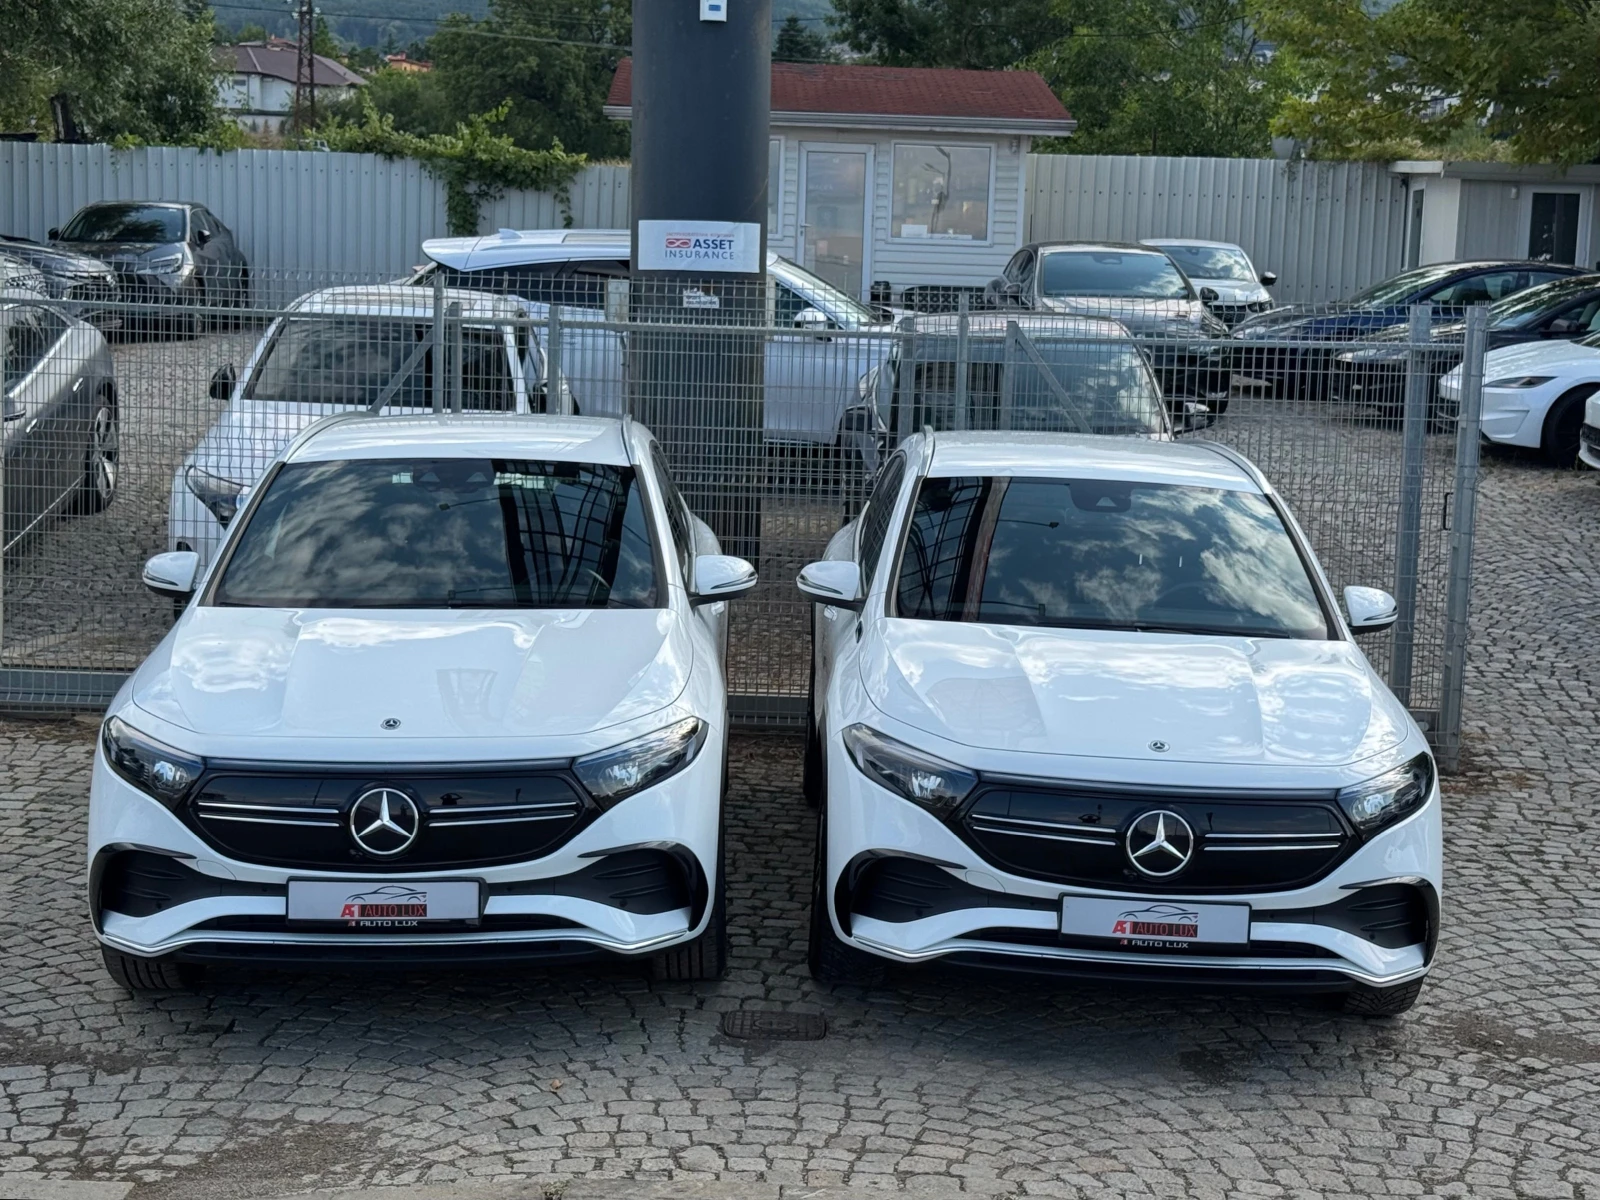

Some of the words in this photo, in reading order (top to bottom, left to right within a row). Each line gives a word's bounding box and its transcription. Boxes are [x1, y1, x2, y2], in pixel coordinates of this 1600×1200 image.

[692, 239, 734, 250] ASSET
[664, 250, 734, 260] INSURANCE
[341, 904, 360, 917] A1
[365, 905, 397, 917] AUTO
[402, 905, 425, 917] LUX
[1112, 920, 1131, 934] A1
[1136, 923, 1168, 936] AUTO
[1172, 925, 1196, 937] LUX
